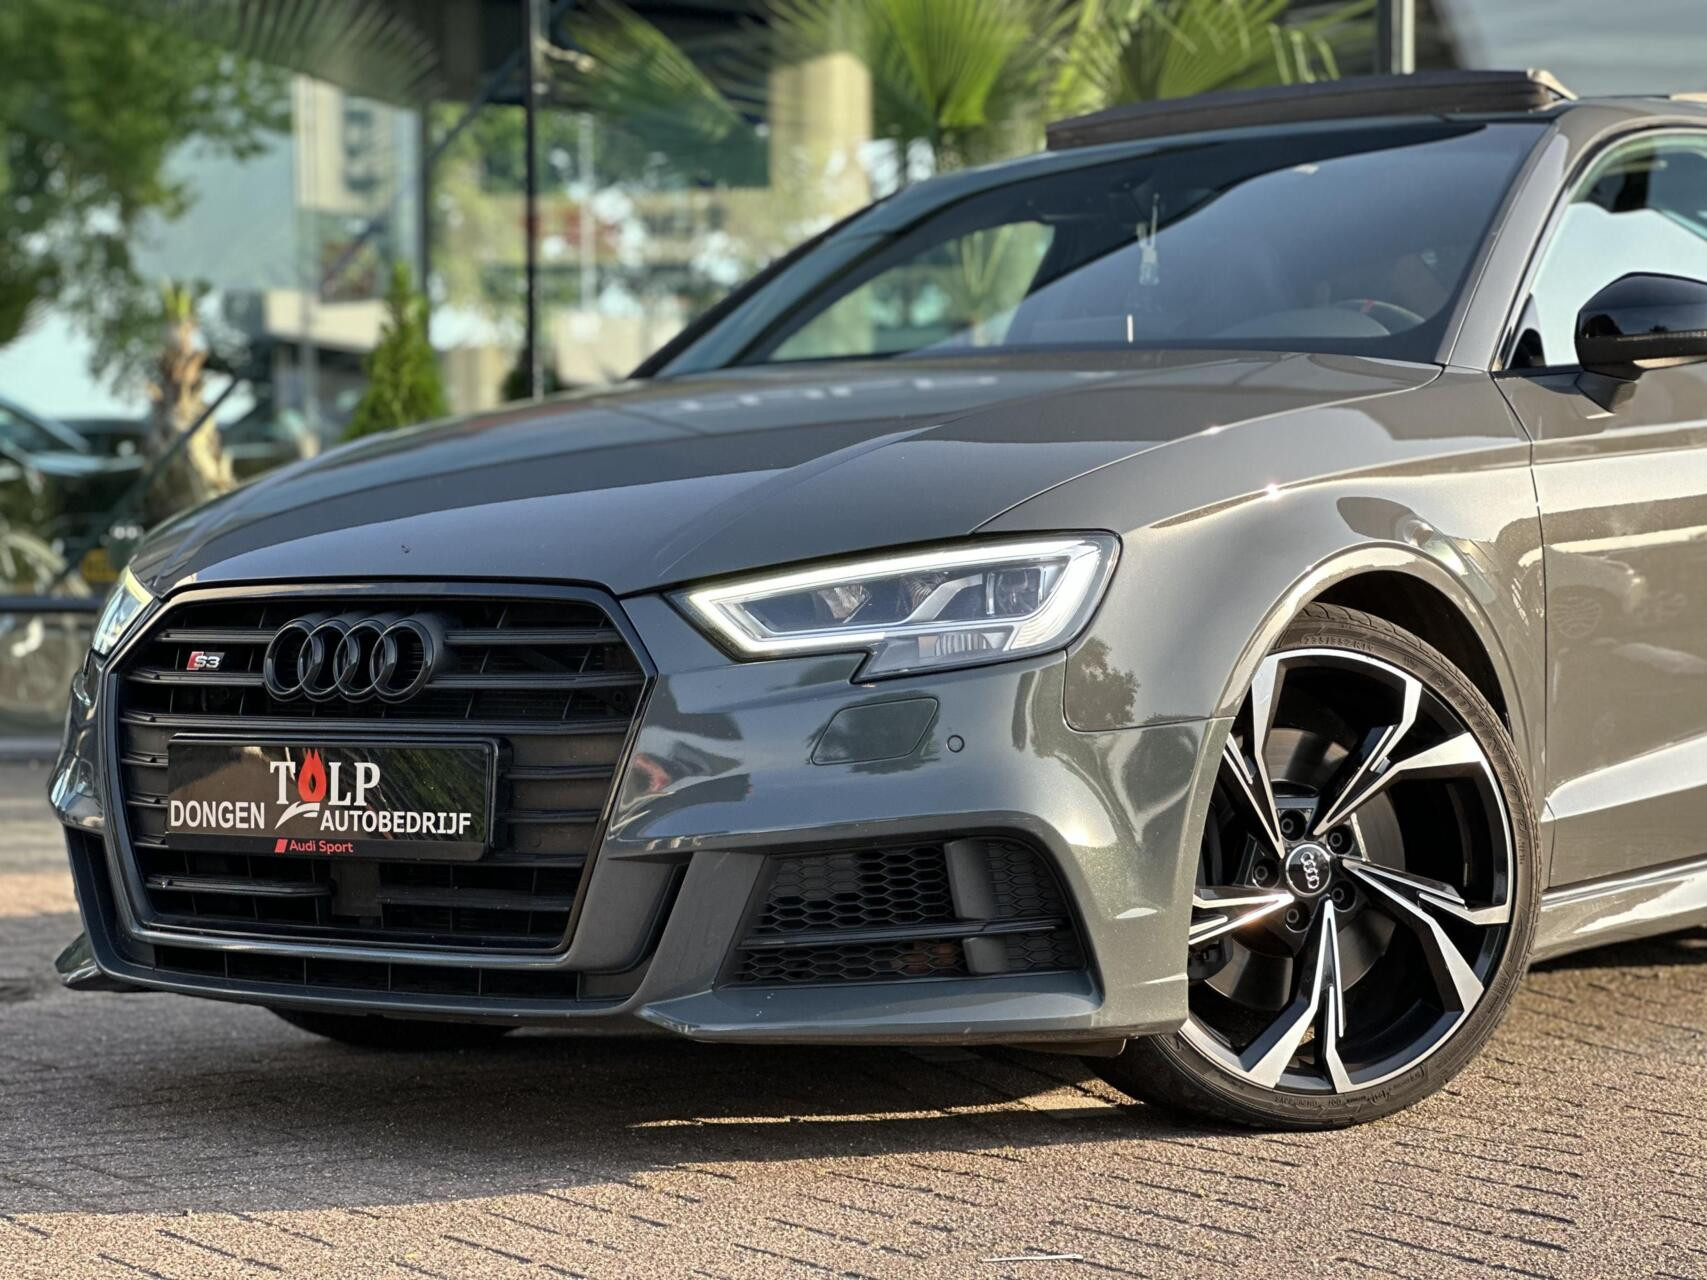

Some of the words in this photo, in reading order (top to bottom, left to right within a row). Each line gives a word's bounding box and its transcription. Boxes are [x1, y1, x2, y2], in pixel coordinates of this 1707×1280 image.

[193, 654, 221, 668] S3
[169, 800, 265, 830] DONGEN
[319, 810, 472, 835] AUTOBEDRIJF
[289, 839, 316, 852] Audi
[318, 840, 354, 855] Sport
